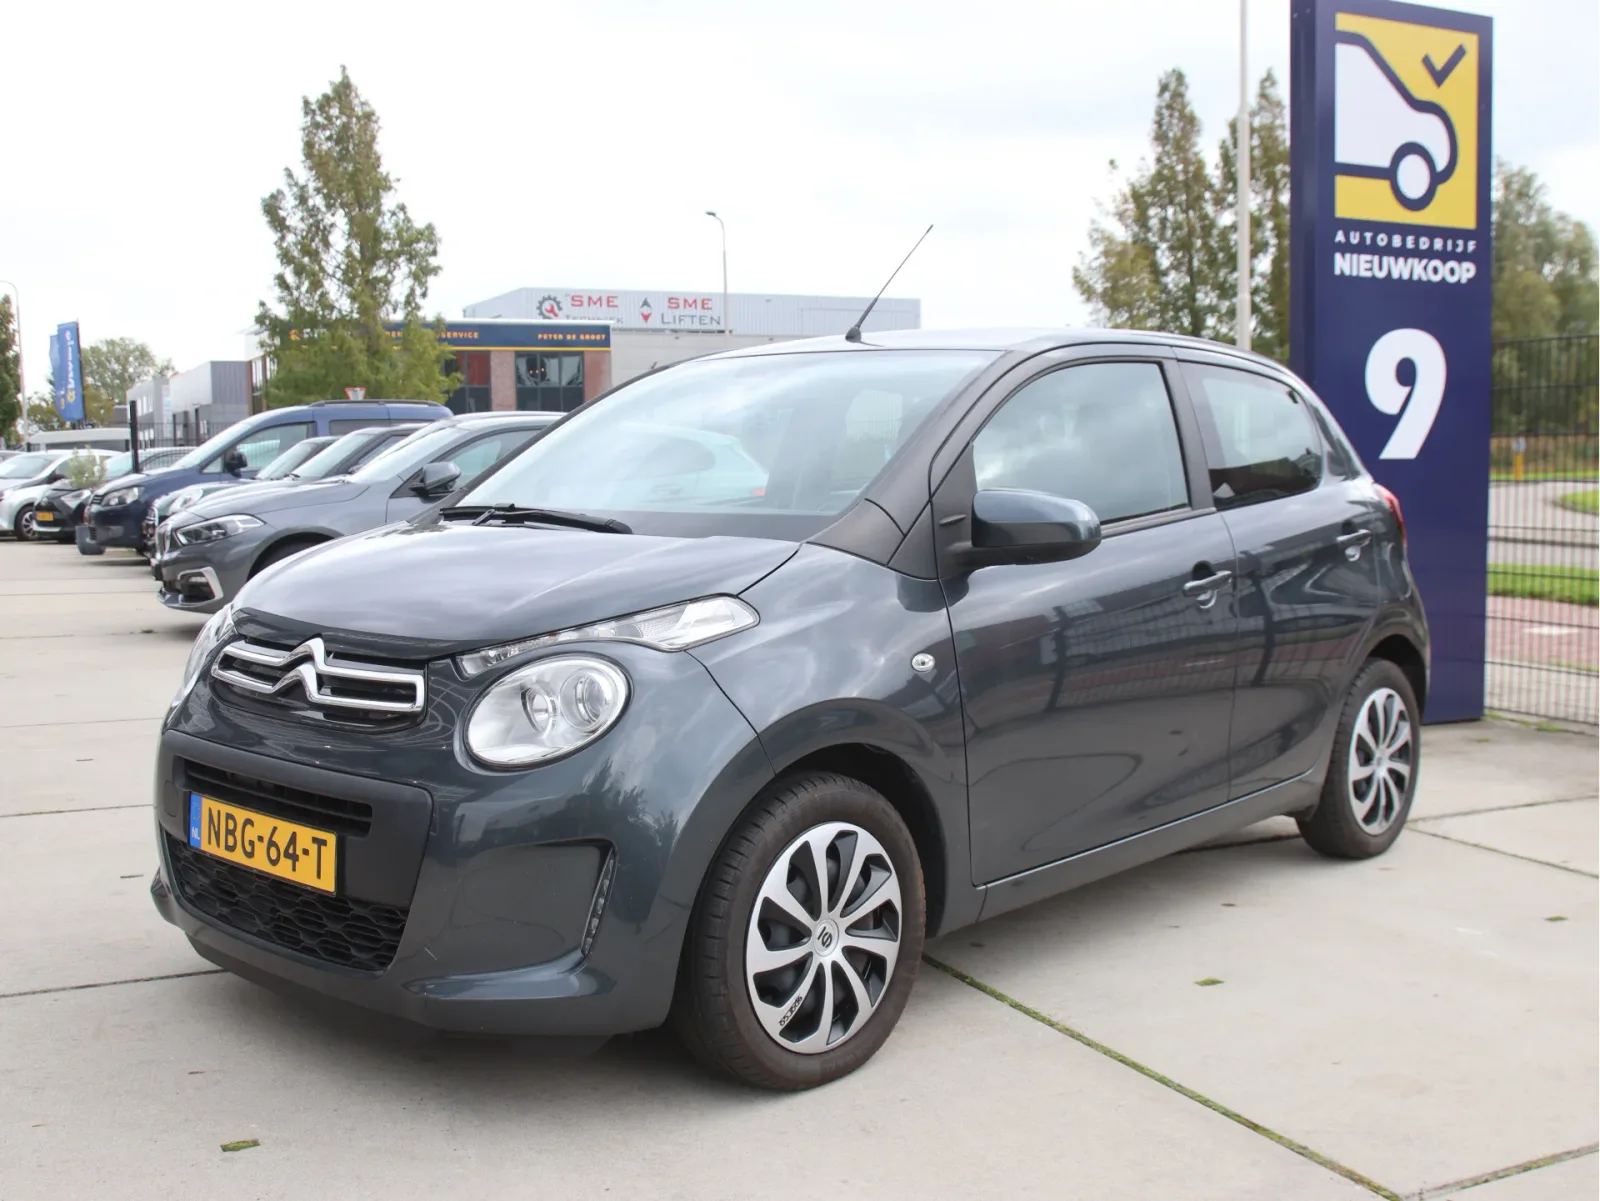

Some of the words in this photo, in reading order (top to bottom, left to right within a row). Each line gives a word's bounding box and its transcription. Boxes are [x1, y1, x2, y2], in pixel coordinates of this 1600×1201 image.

[1334, 229, 1477, 253] AUTOBEDRIJF
[1333, 252, 1477, 284] NIEUWKOOP
[570, 294, 619, 308] SME
[667, 297, 713, 311] SME
[661, 312, 721, 326] LIFTEN
[441, 331, 479, 339] SERVICE
[1365, 328, 1447, 460] 9
[191, 826, 201, 841] NL
[207, 806, 328, 880] NBG-64-T
